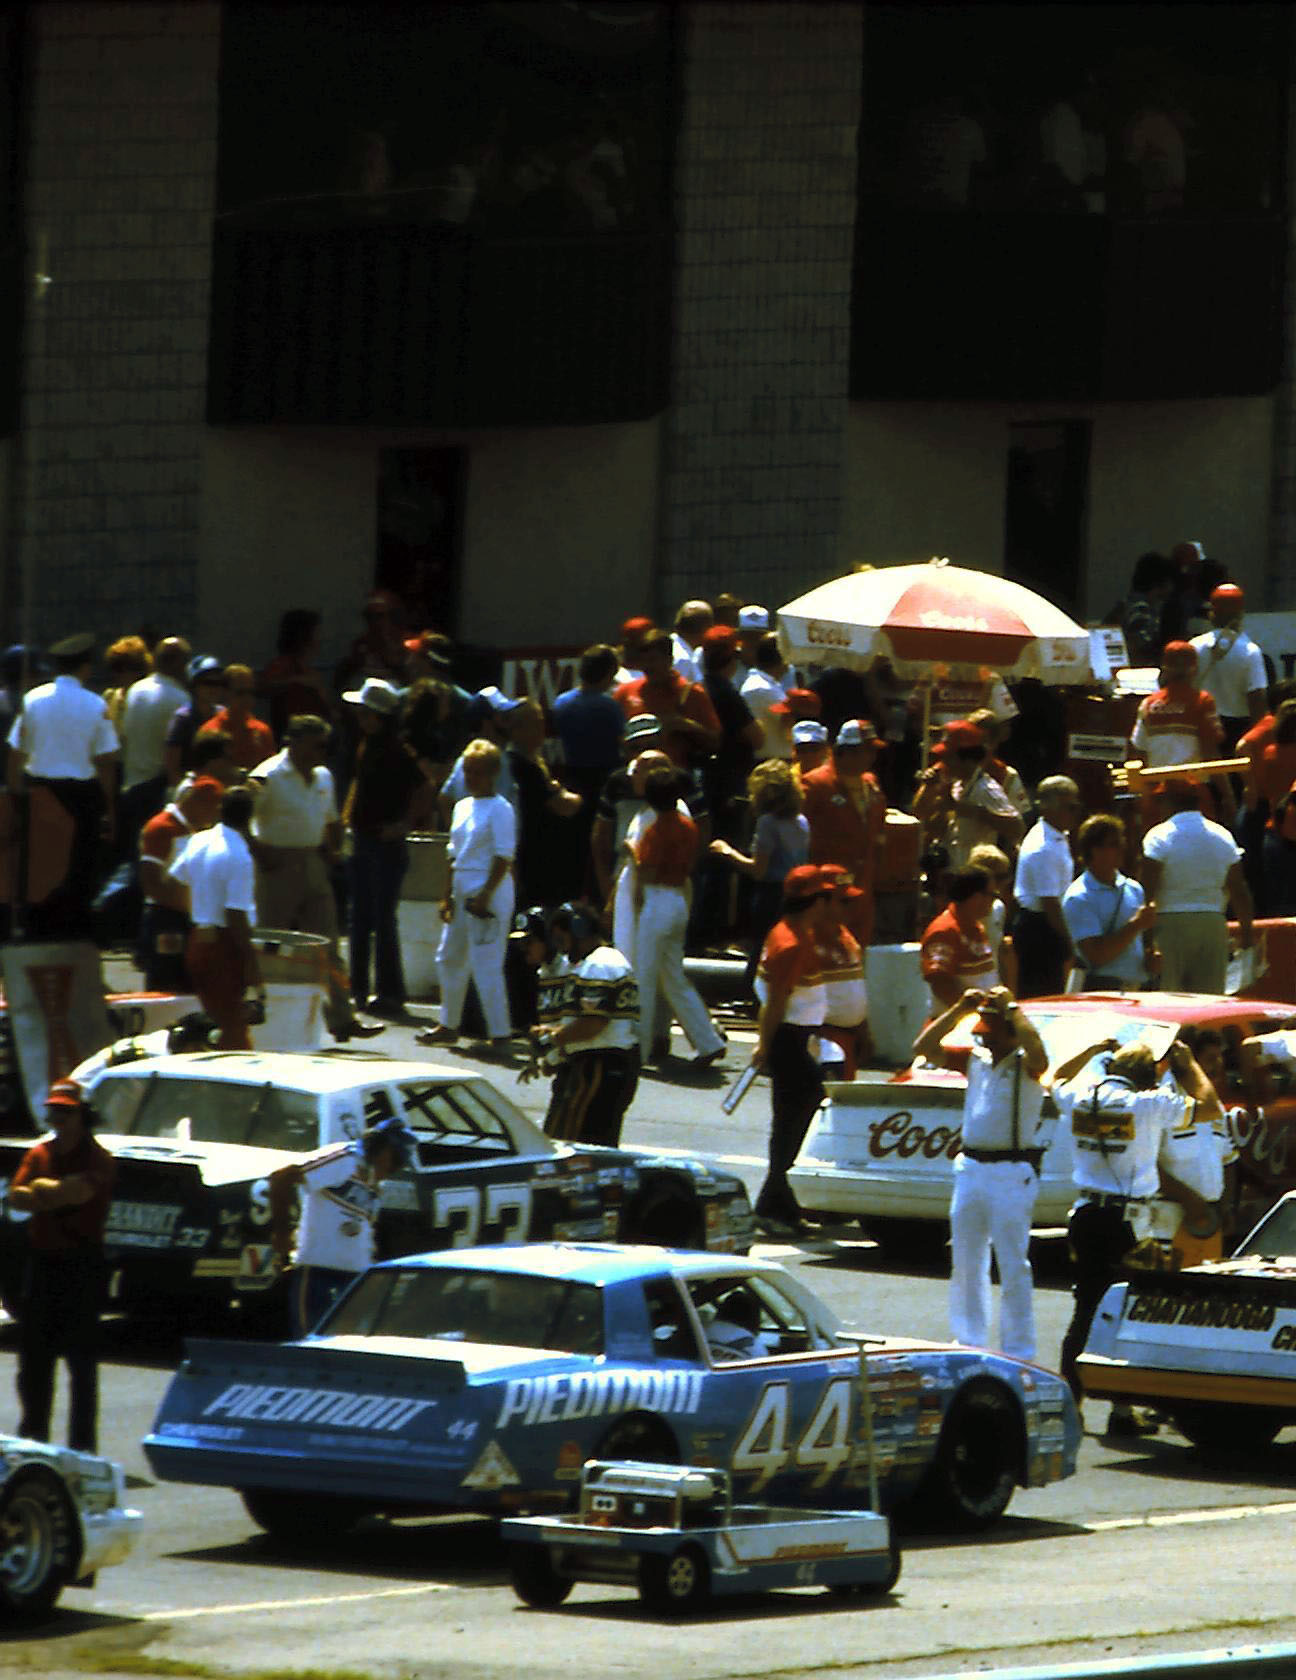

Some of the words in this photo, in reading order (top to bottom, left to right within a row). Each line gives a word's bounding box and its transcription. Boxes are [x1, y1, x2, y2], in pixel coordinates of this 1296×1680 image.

[1127, 1295, 1276, 1332] CHATTANOOGA
[202, 1383, 438, 1432] PIEDMONT
[496, 1369, 706, 1429] PIEDMONT
[732, 1377, 856, 1493] 44
